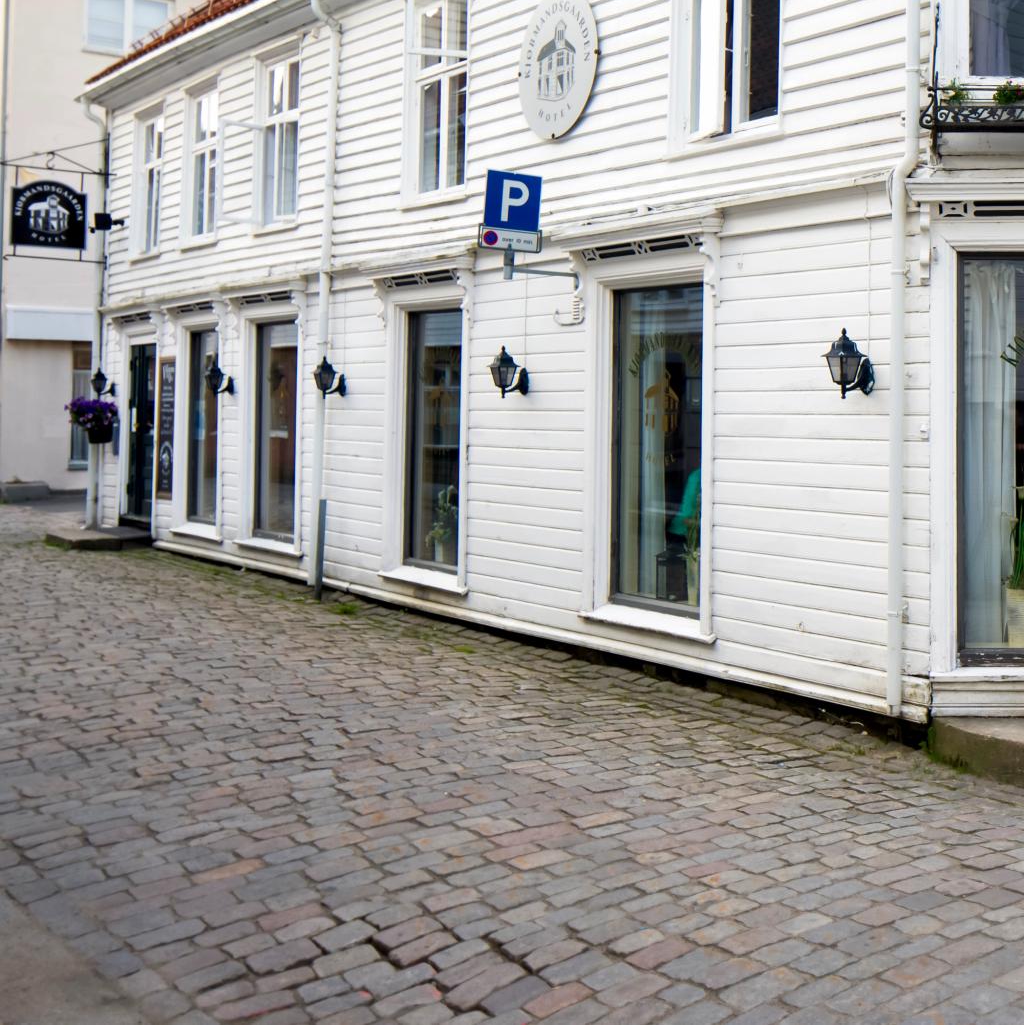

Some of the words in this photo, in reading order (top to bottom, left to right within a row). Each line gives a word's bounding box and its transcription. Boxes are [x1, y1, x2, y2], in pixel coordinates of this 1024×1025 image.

[538, 103, 572, 122] HOTEL
[501, 179, 529, 222] P
[31, 232, 66, 243] HOTEL
